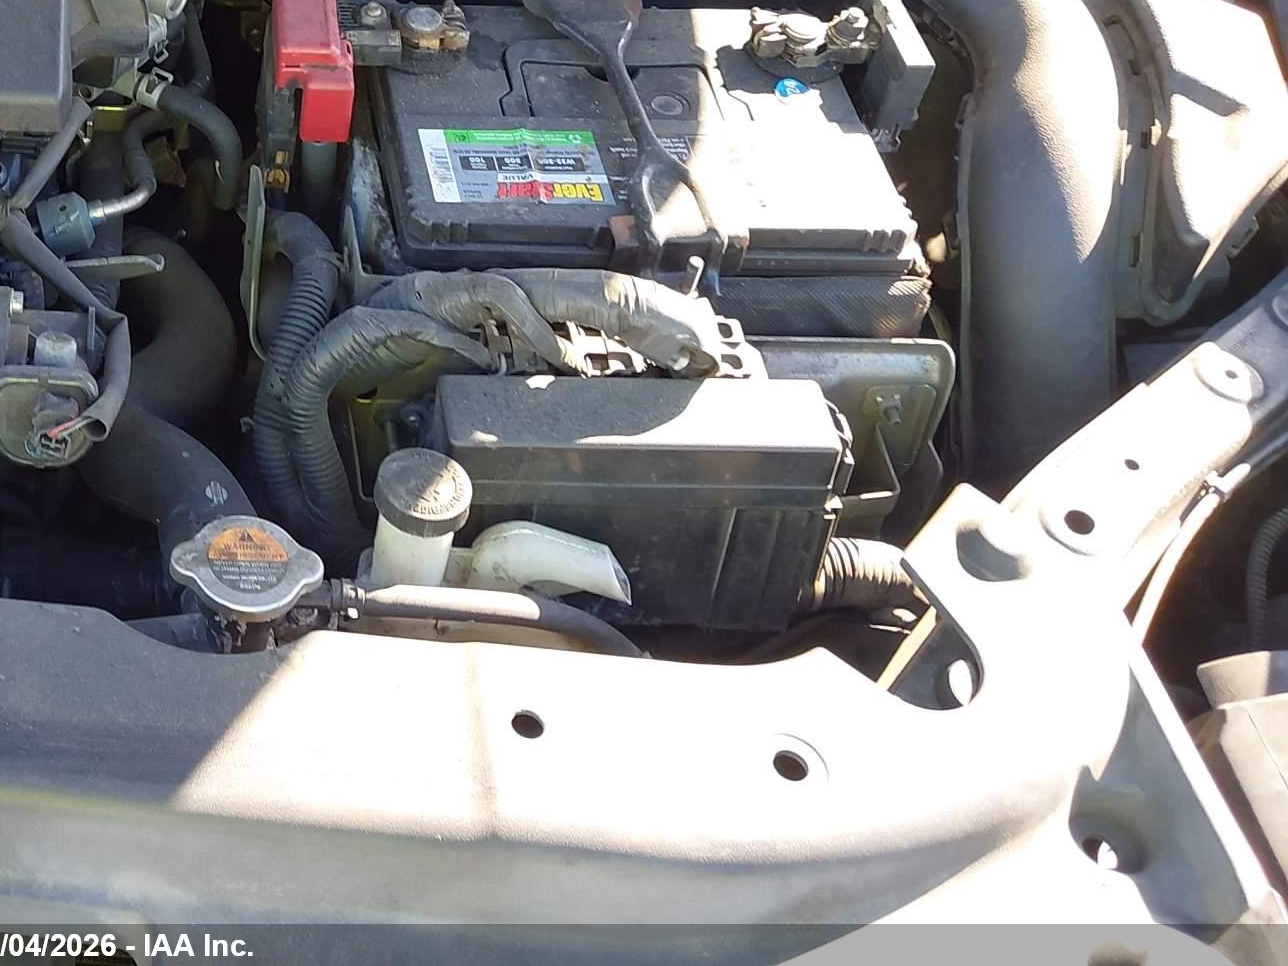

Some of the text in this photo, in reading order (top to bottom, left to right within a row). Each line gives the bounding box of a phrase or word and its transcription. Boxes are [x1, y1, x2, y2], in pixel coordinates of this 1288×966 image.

[500, 173, 534, 181] VALUE
[494, 180, 604, 202] EverStart
[223, 542, 272, 551] WARNING
